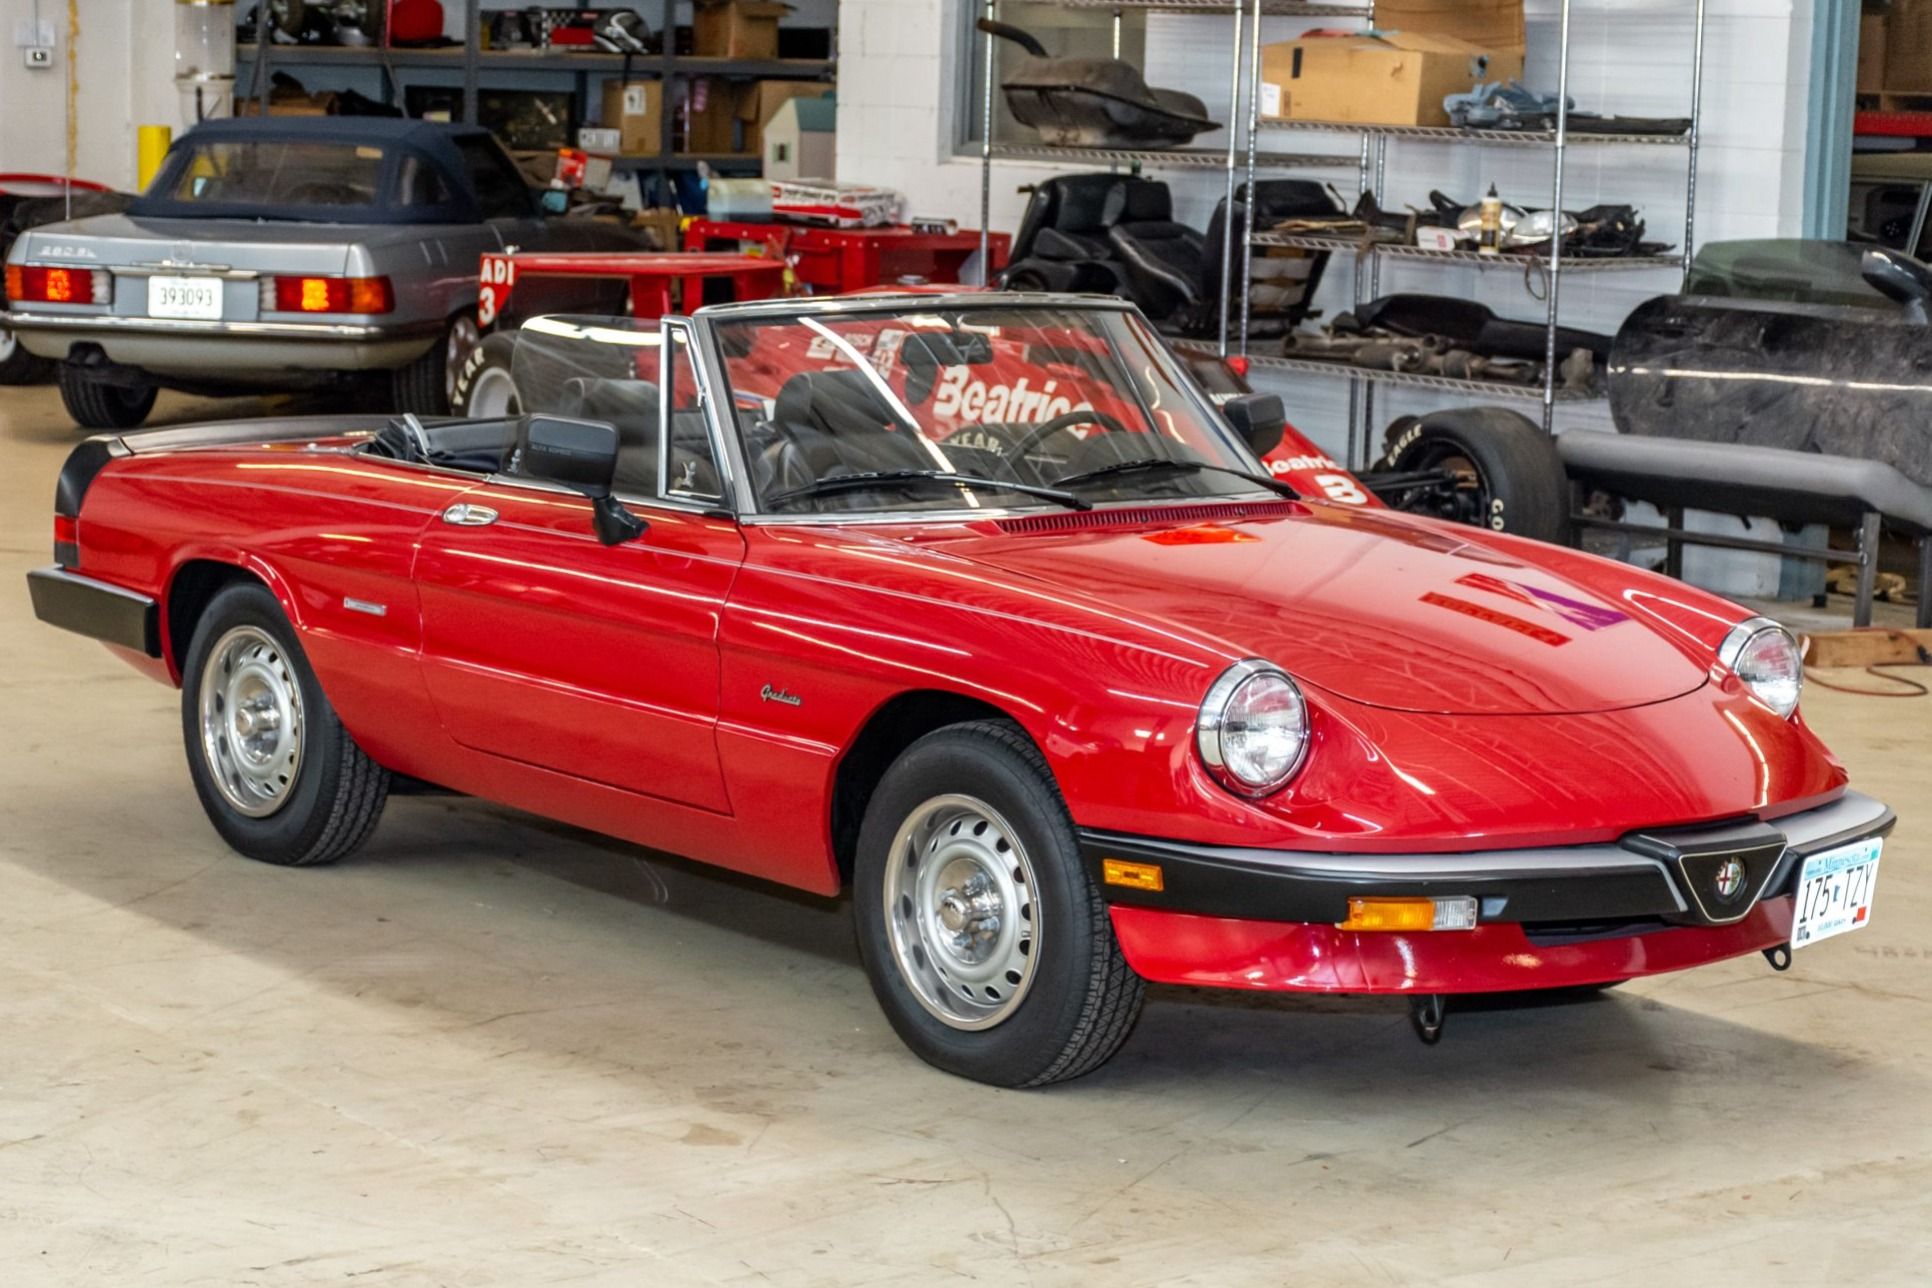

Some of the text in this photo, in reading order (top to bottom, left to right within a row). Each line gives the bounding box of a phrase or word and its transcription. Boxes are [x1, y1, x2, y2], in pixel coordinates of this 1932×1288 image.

[160, 287, 212, 306] 393093
[479, 287, 495, 324] 3
[1387, 424, 1422, 467] EAGLE
[1800, 863, 1874, 924] 175 TZY
